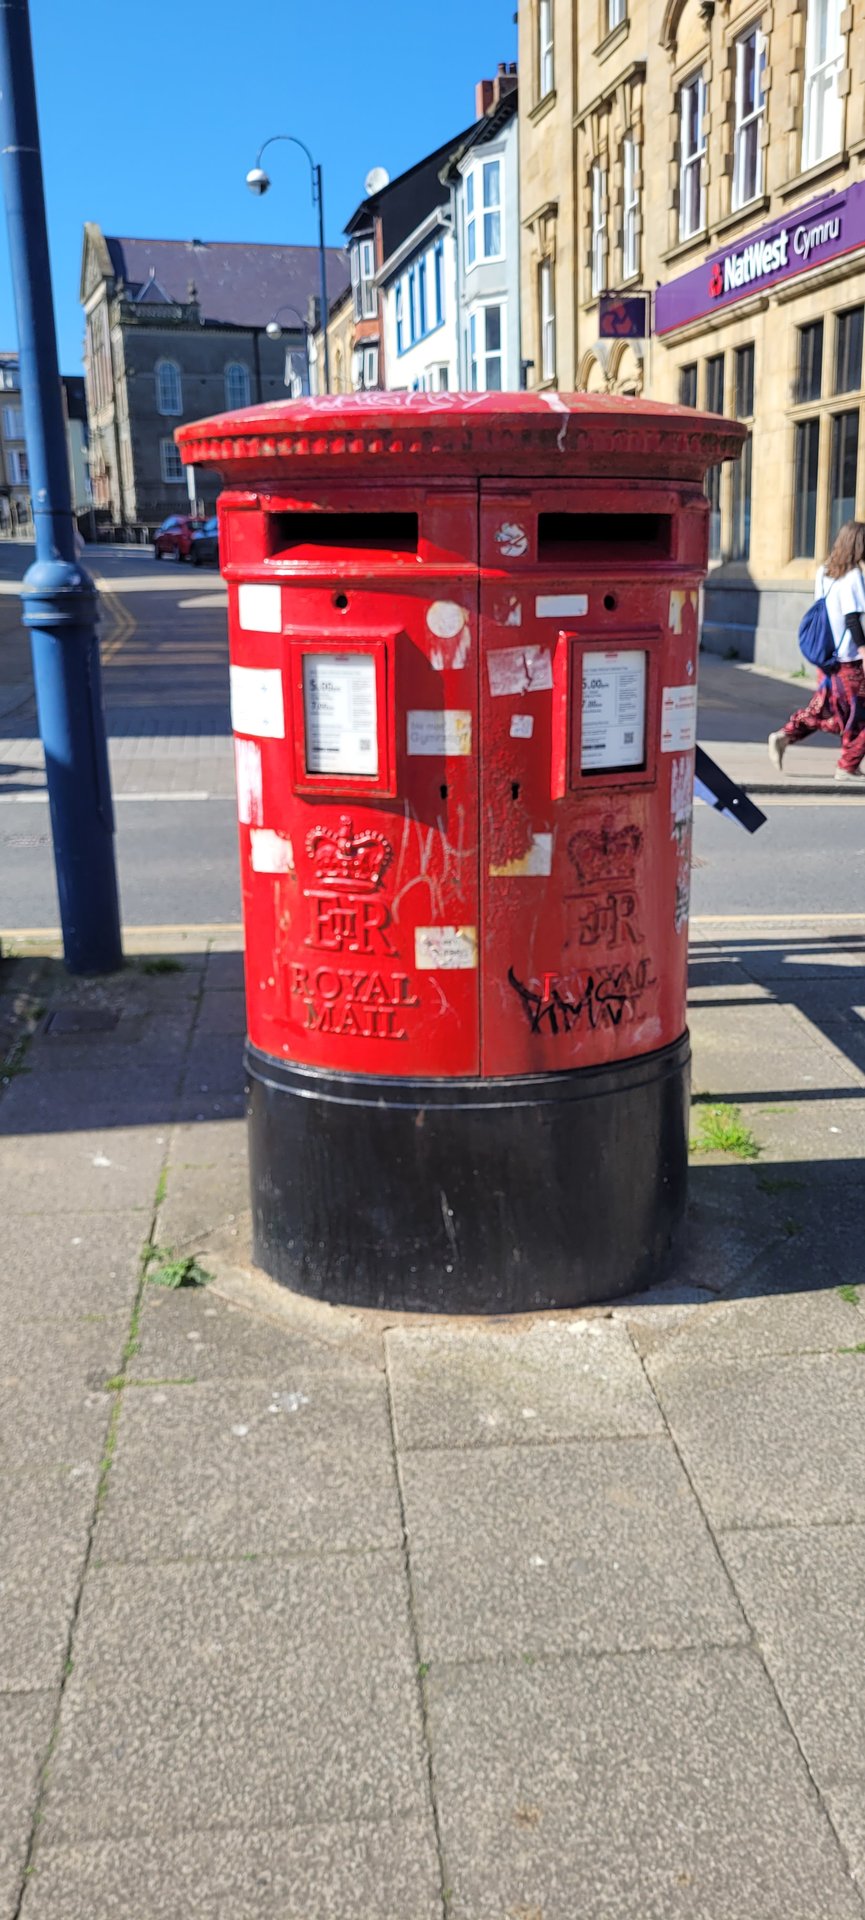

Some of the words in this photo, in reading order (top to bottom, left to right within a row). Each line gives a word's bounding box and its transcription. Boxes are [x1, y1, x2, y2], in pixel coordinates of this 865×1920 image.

[724, 229, 789, 292] NatWest
[793, 217, 841, 260] Cymru
[289, 962, 420, 1007] ROYAL
[303, 997, 409, 1040] MAIL
